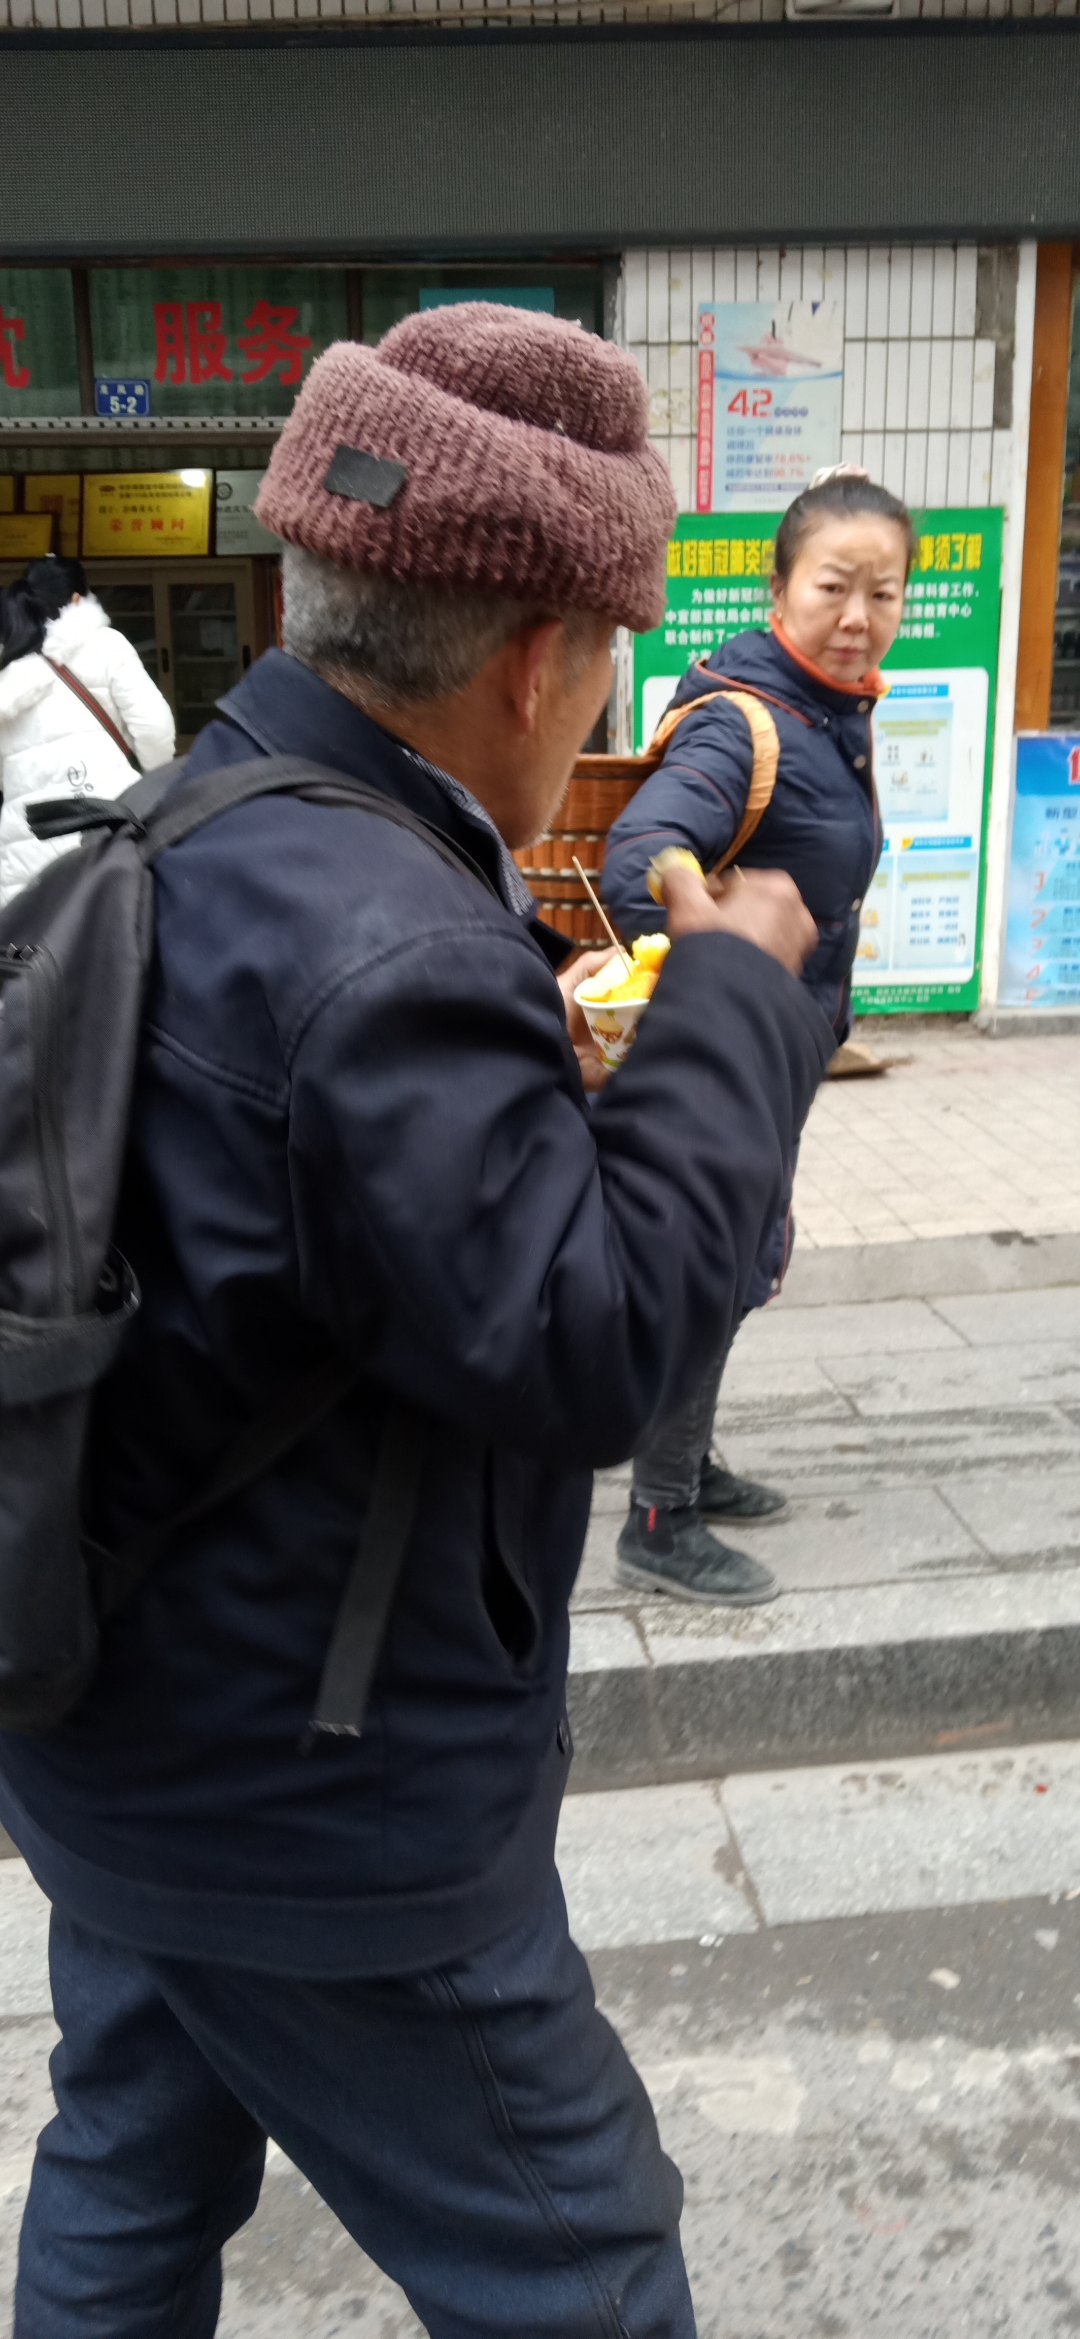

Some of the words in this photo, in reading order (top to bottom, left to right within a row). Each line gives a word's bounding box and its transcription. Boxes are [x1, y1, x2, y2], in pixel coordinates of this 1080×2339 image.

[153, 299, 311, 385] 服务
[110, 395, 137, 414] 5-2
[726, 387, 774, 418] 42
